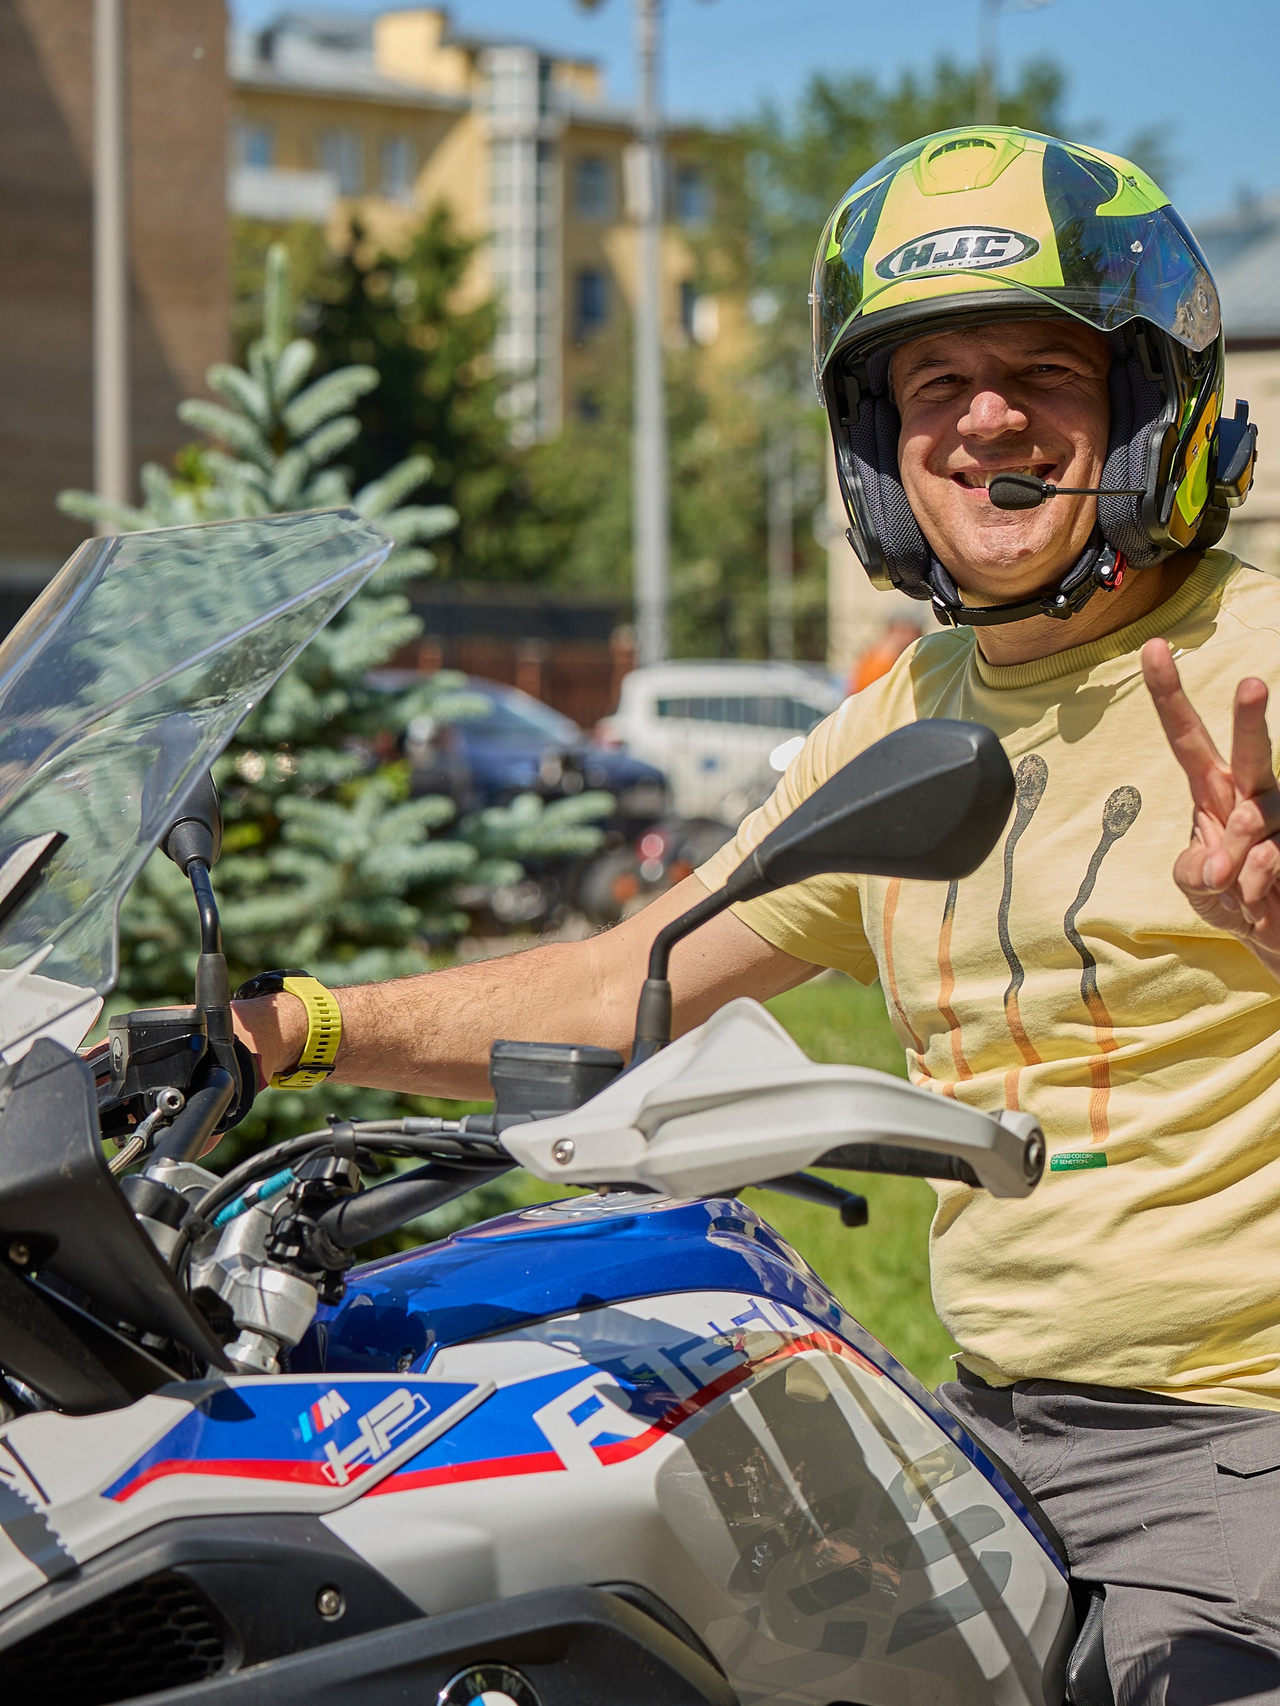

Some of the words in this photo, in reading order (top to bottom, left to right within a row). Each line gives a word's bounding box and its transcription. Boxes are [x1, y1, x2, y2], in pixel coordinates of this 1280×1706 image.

[898, 235, 1012, 273] HJC
[322, 1388, 421, 1487] HP
[446, 1672, 523, 1706] MW
